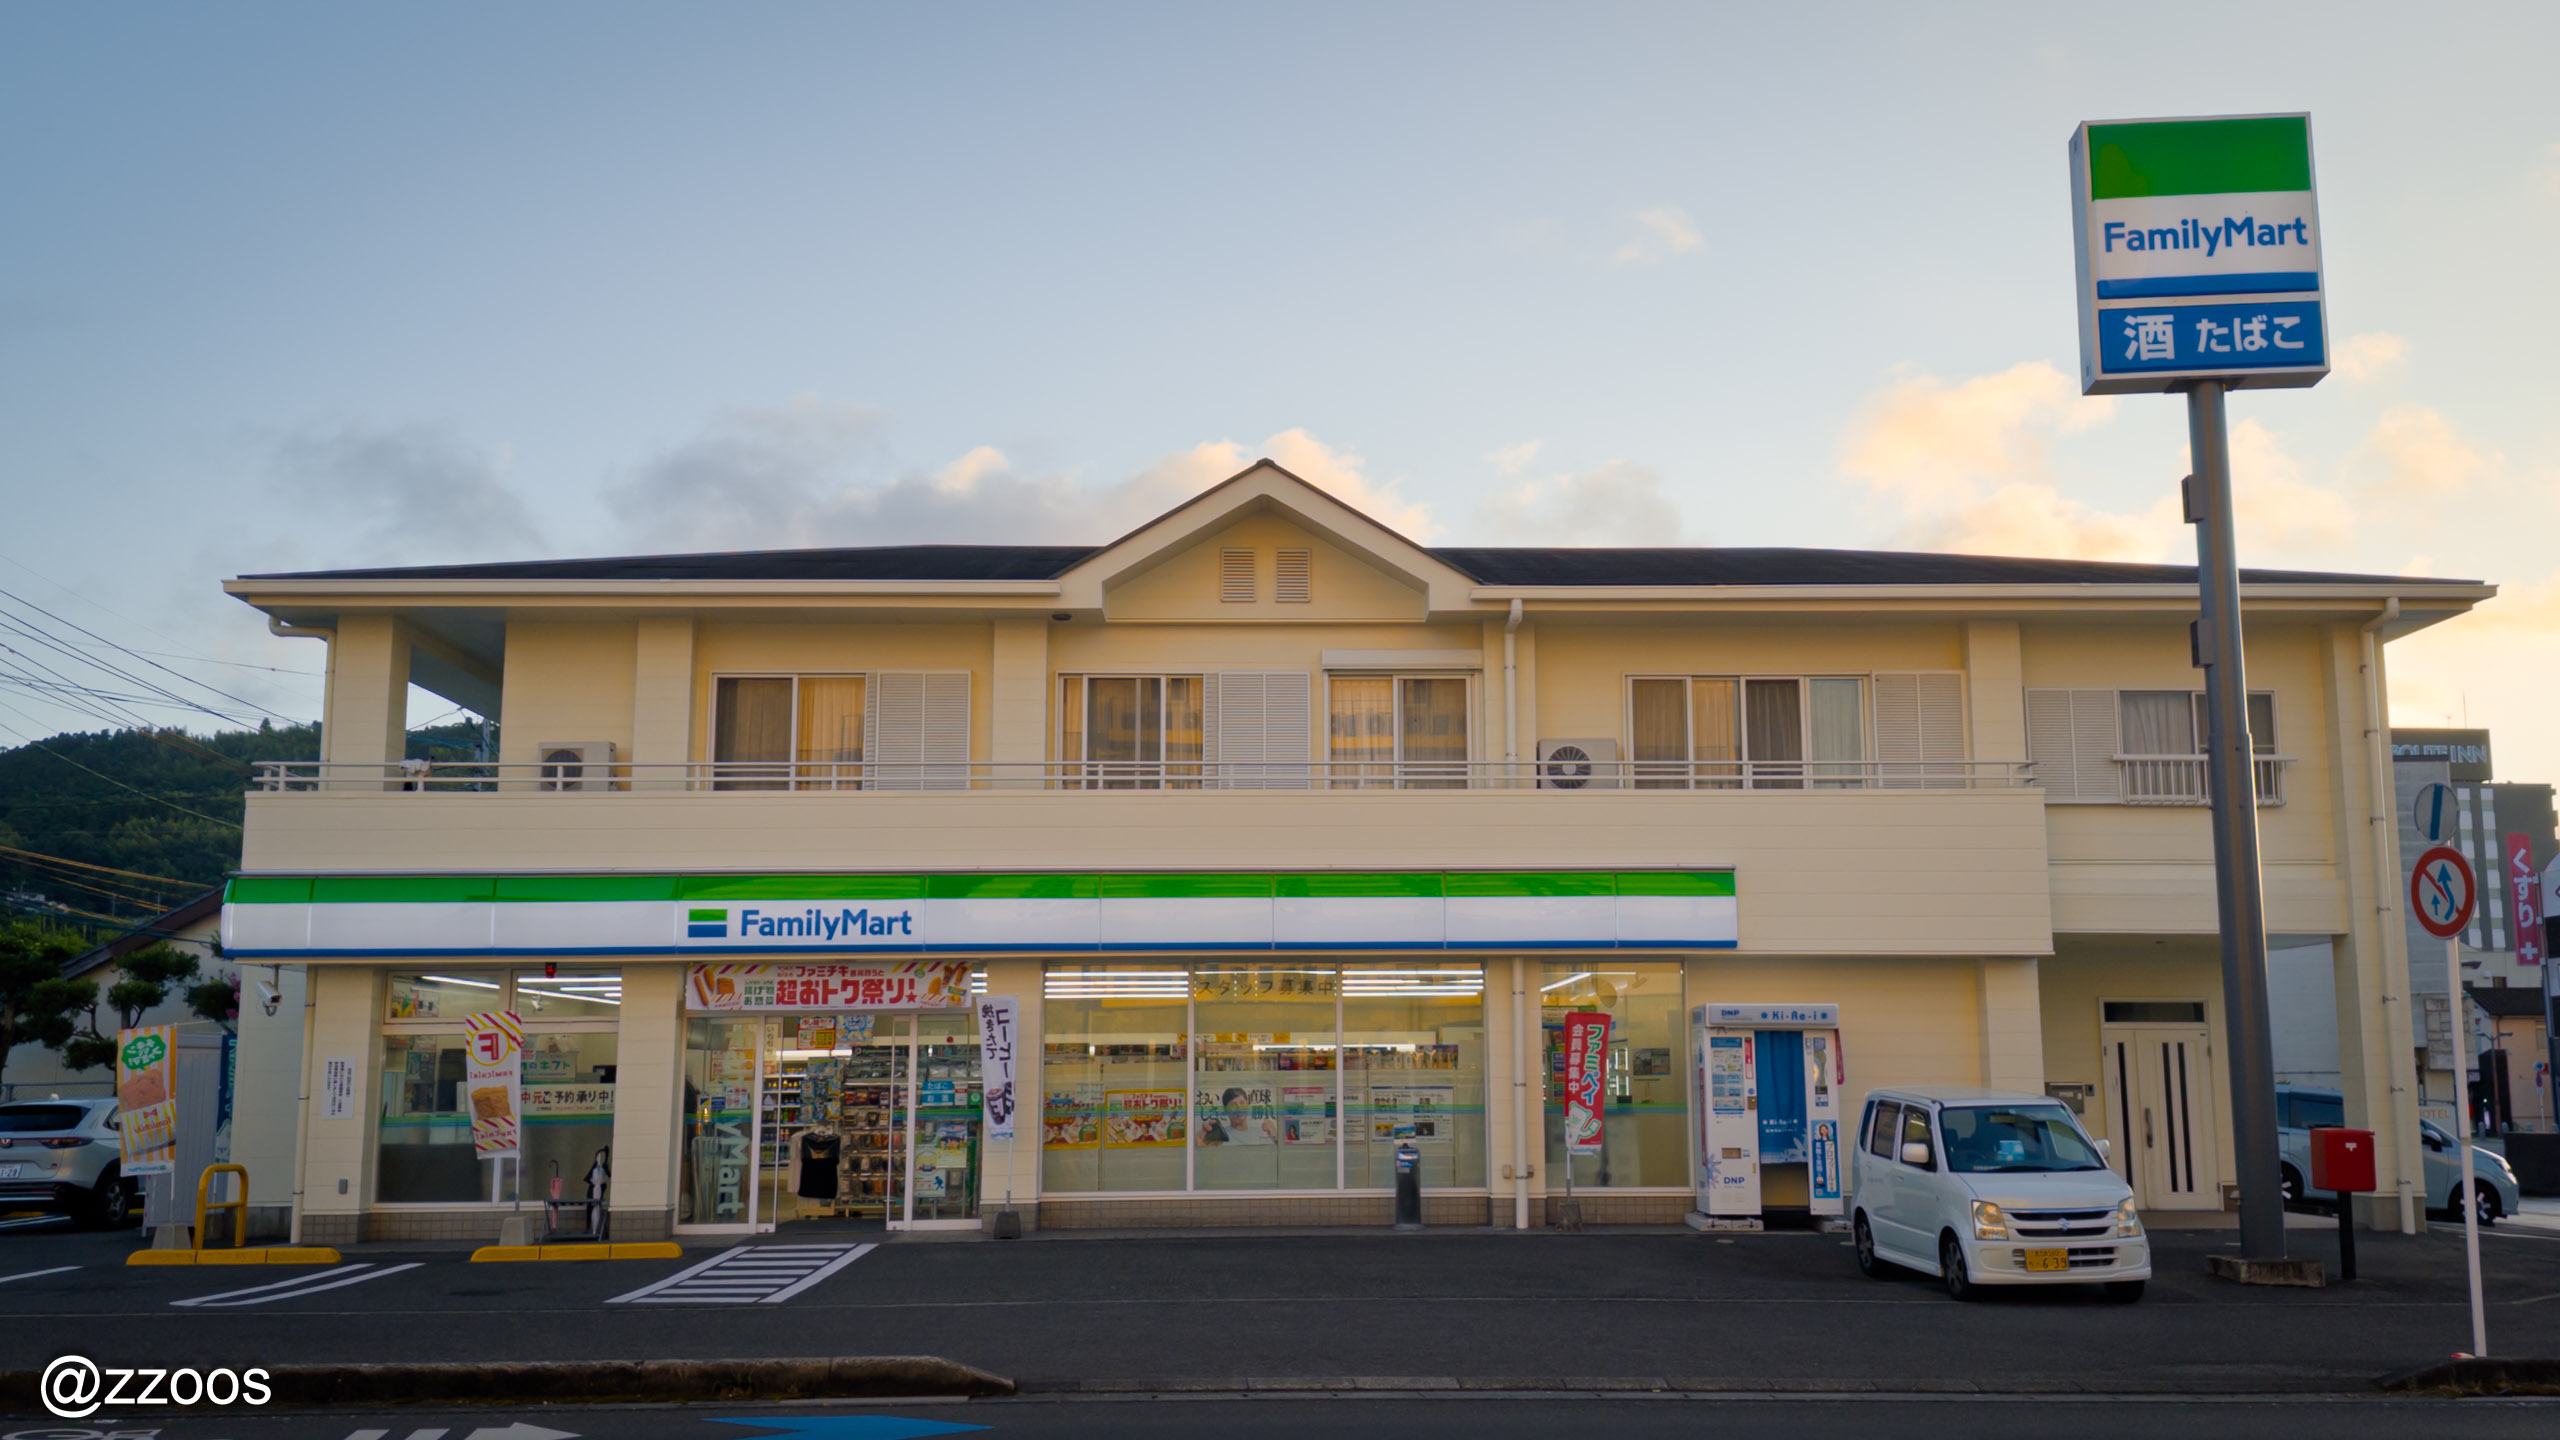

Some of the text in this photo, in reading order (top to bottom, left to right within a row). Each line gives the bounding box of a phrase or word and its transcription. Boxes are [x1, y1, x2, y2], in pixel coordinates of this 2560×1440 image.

[2104, 216, 2308, 257] FamilyMart
[2123, 314, 2304, 360] 酒 たばこ
[2449, 744, 2488, 763] INN
[2513, 847, 2534, 929] くすり
[741, 909, 912, 940] FamilyMart
[795, 965, 848, 977] ファミチキ
[1198, 979, 1333, 995] スタッフ募集中
[1567, 1024, 1584, 1093] 会員募集中
[1581, 1024, 1604, 1105] ファミペイ
